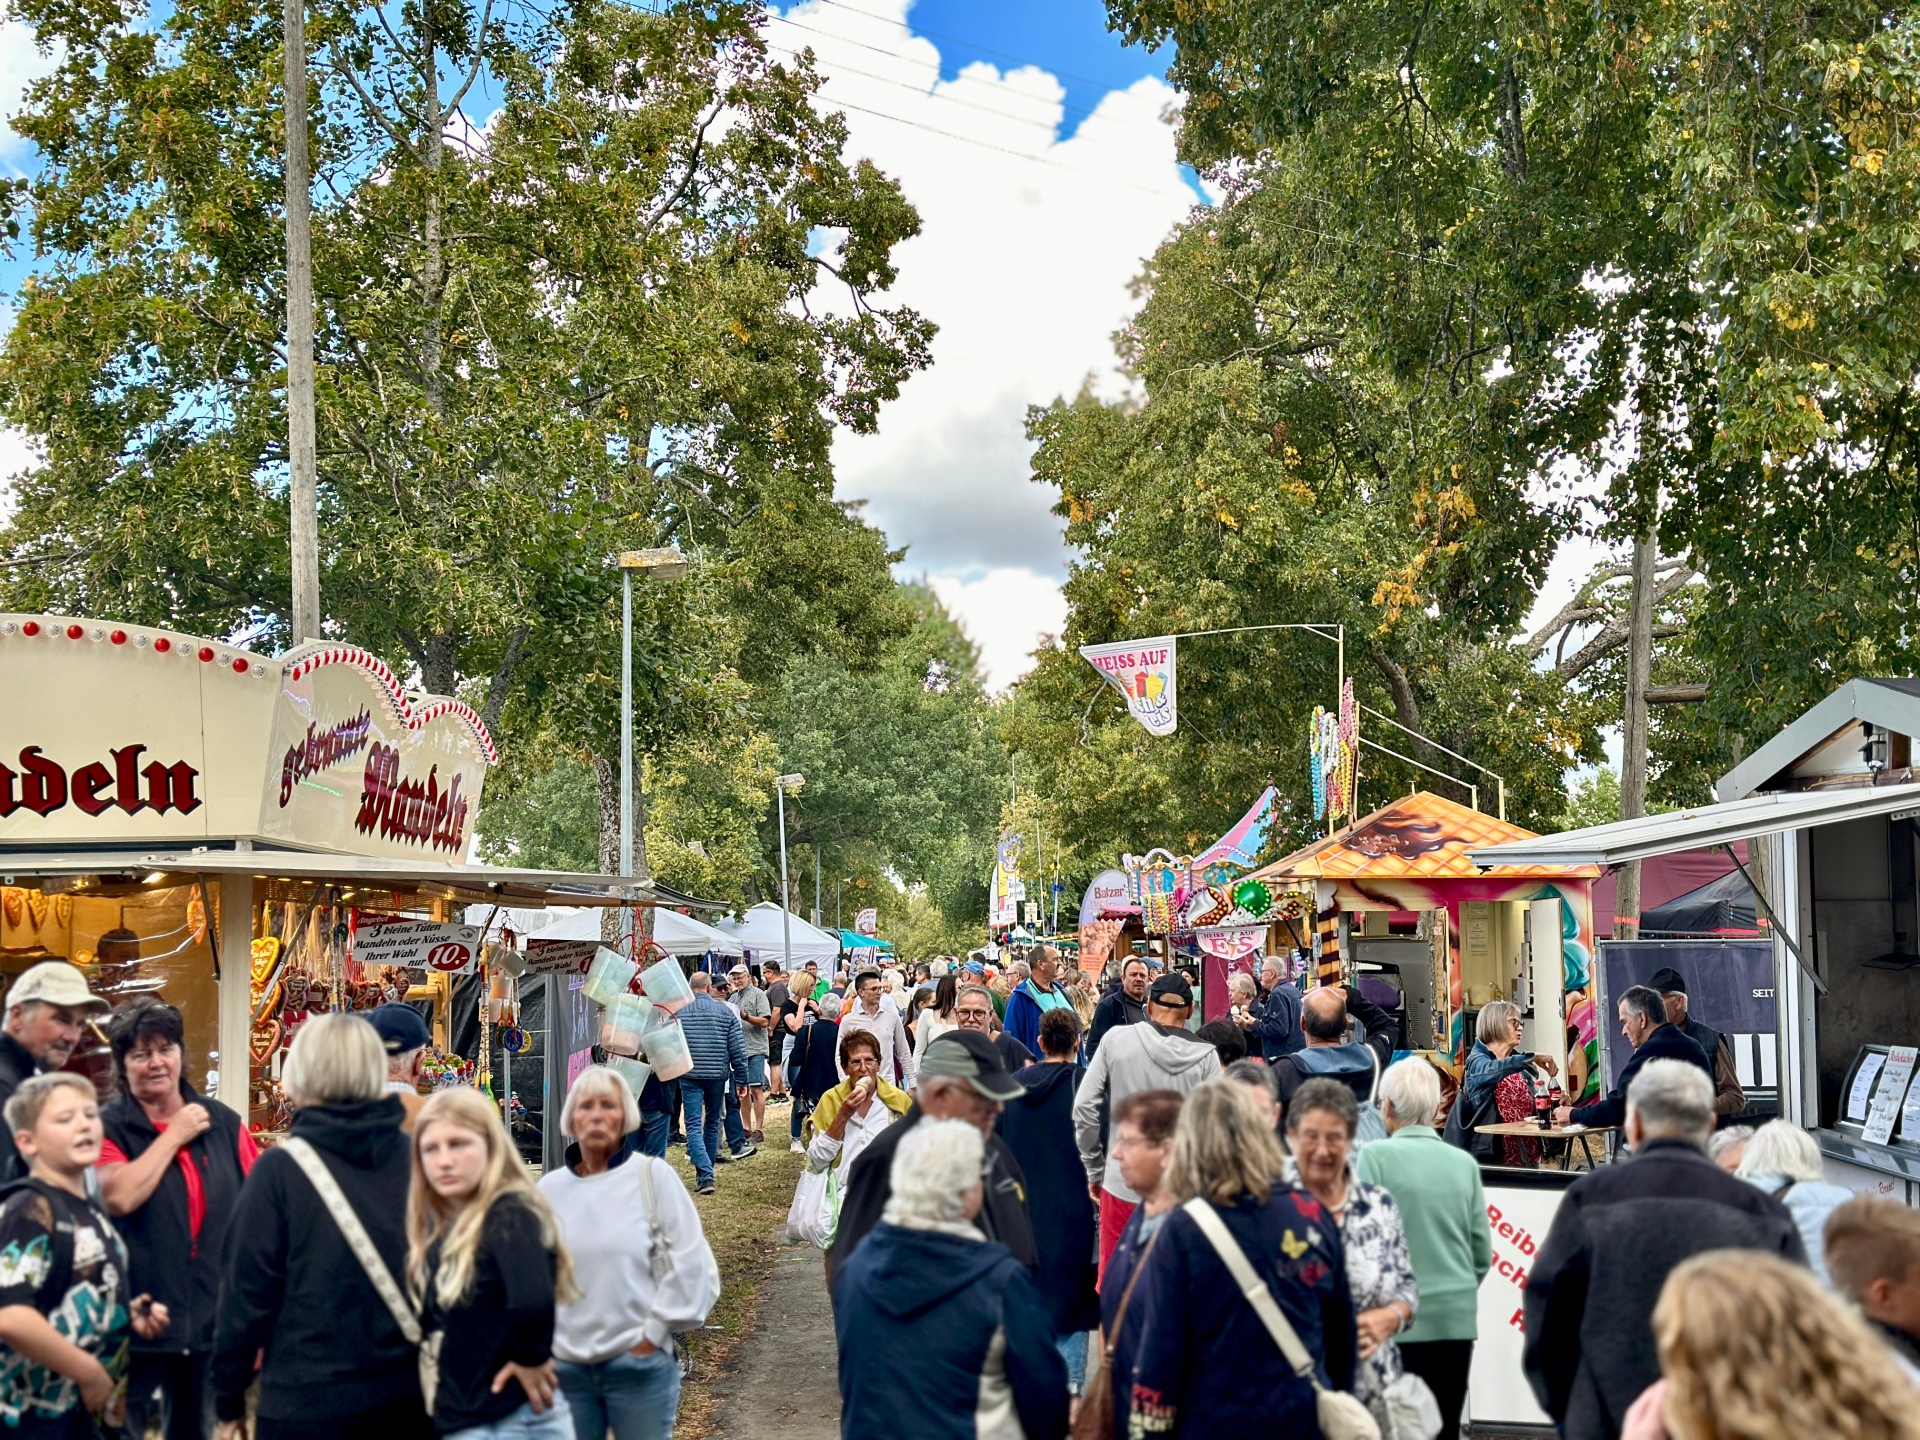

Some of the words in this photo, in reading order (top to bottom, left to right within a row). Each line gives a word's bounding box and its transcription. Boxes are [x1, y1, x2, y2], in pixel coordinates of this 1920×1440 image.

[1140, 649, 1168, 666] AUF
[354, 741, 467, 856] Mandeln
[369, 923, 382, 938] 3
[383, 925, 413, 935] kleine
[415, 923, 442, 932] Tüten
[354, 939, 397, 949] Mandeln
[398, 937, 421, 946] oder
[421, 934, 451, 944] Nüsse
[365, 952, 391, 961] Ihrer
[392, 949, 418, 959] Wahl
[536, 946, 545, 957] 3
[1752, 988, 1775, 998] SEIT
